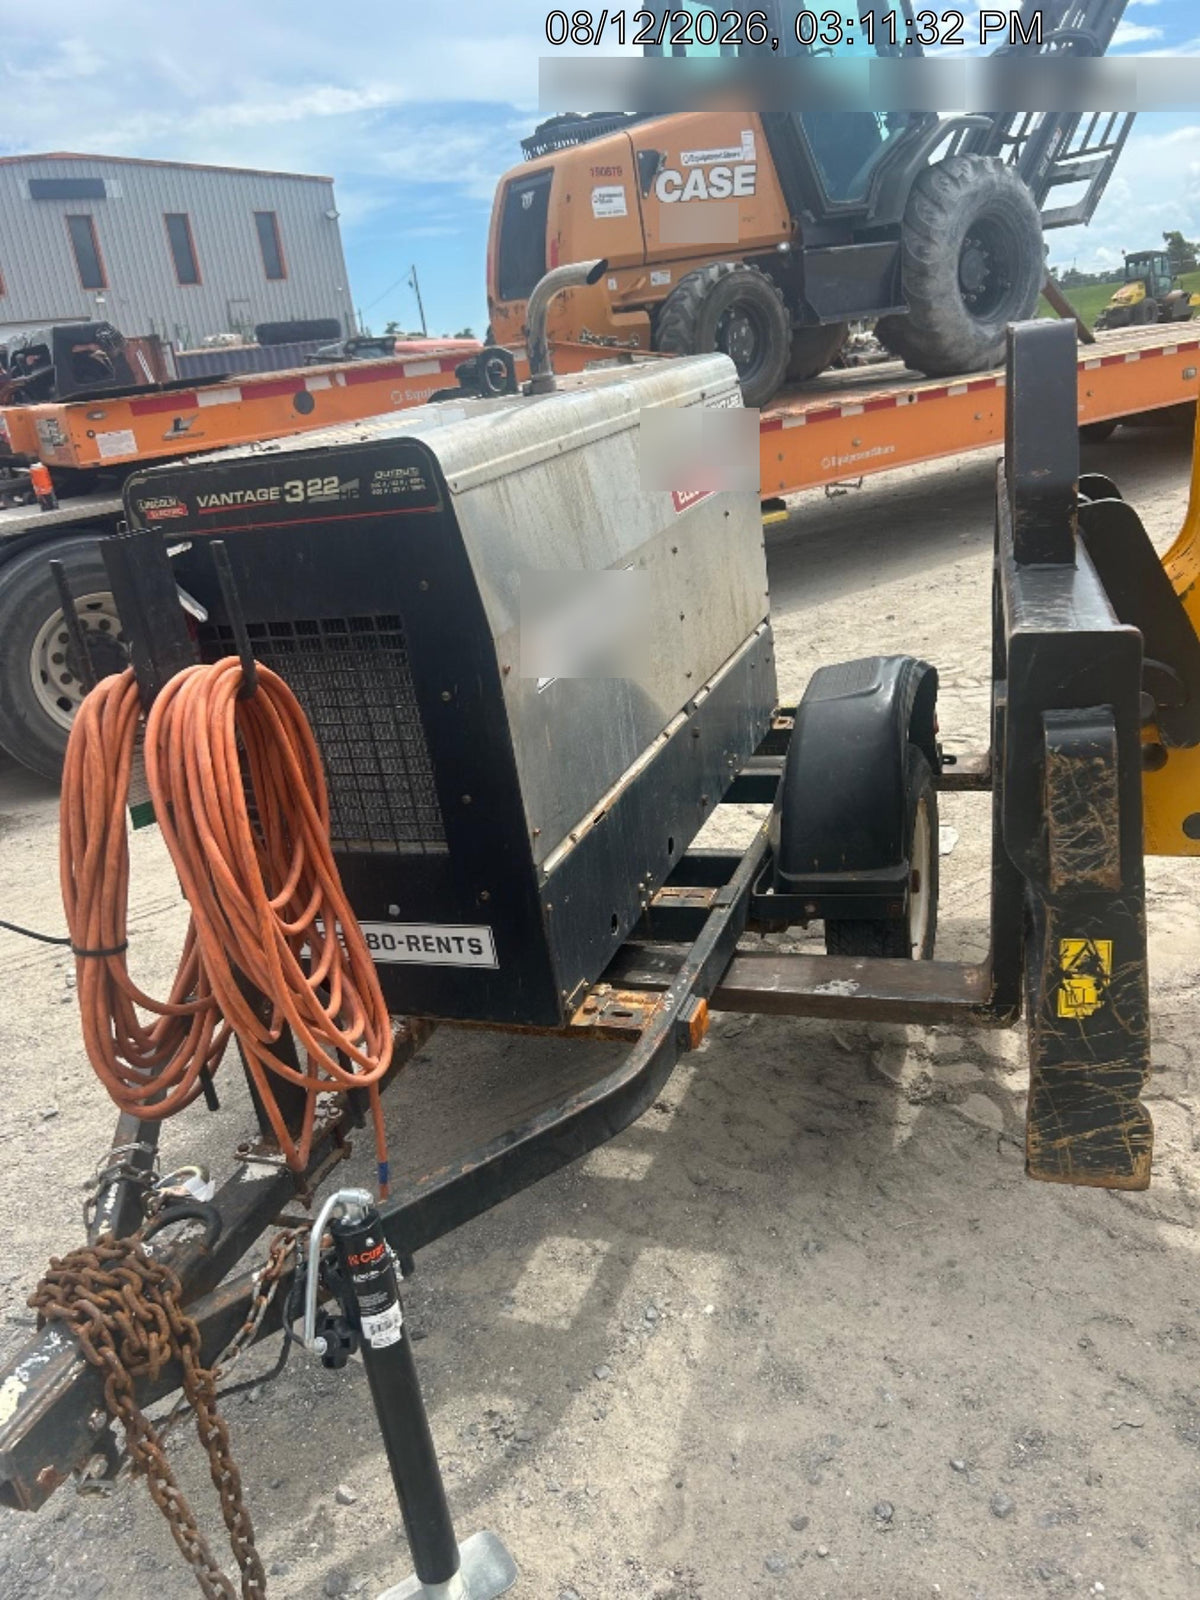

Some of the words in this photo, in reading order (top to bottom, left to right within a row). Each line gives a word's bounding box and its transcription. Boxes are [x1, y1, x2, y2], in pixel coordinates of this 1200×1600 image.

[655, 164, 757, 203] CASE
[196, 487, 281, 508] VANTAGE
[283, 475, 340, 503] 322
